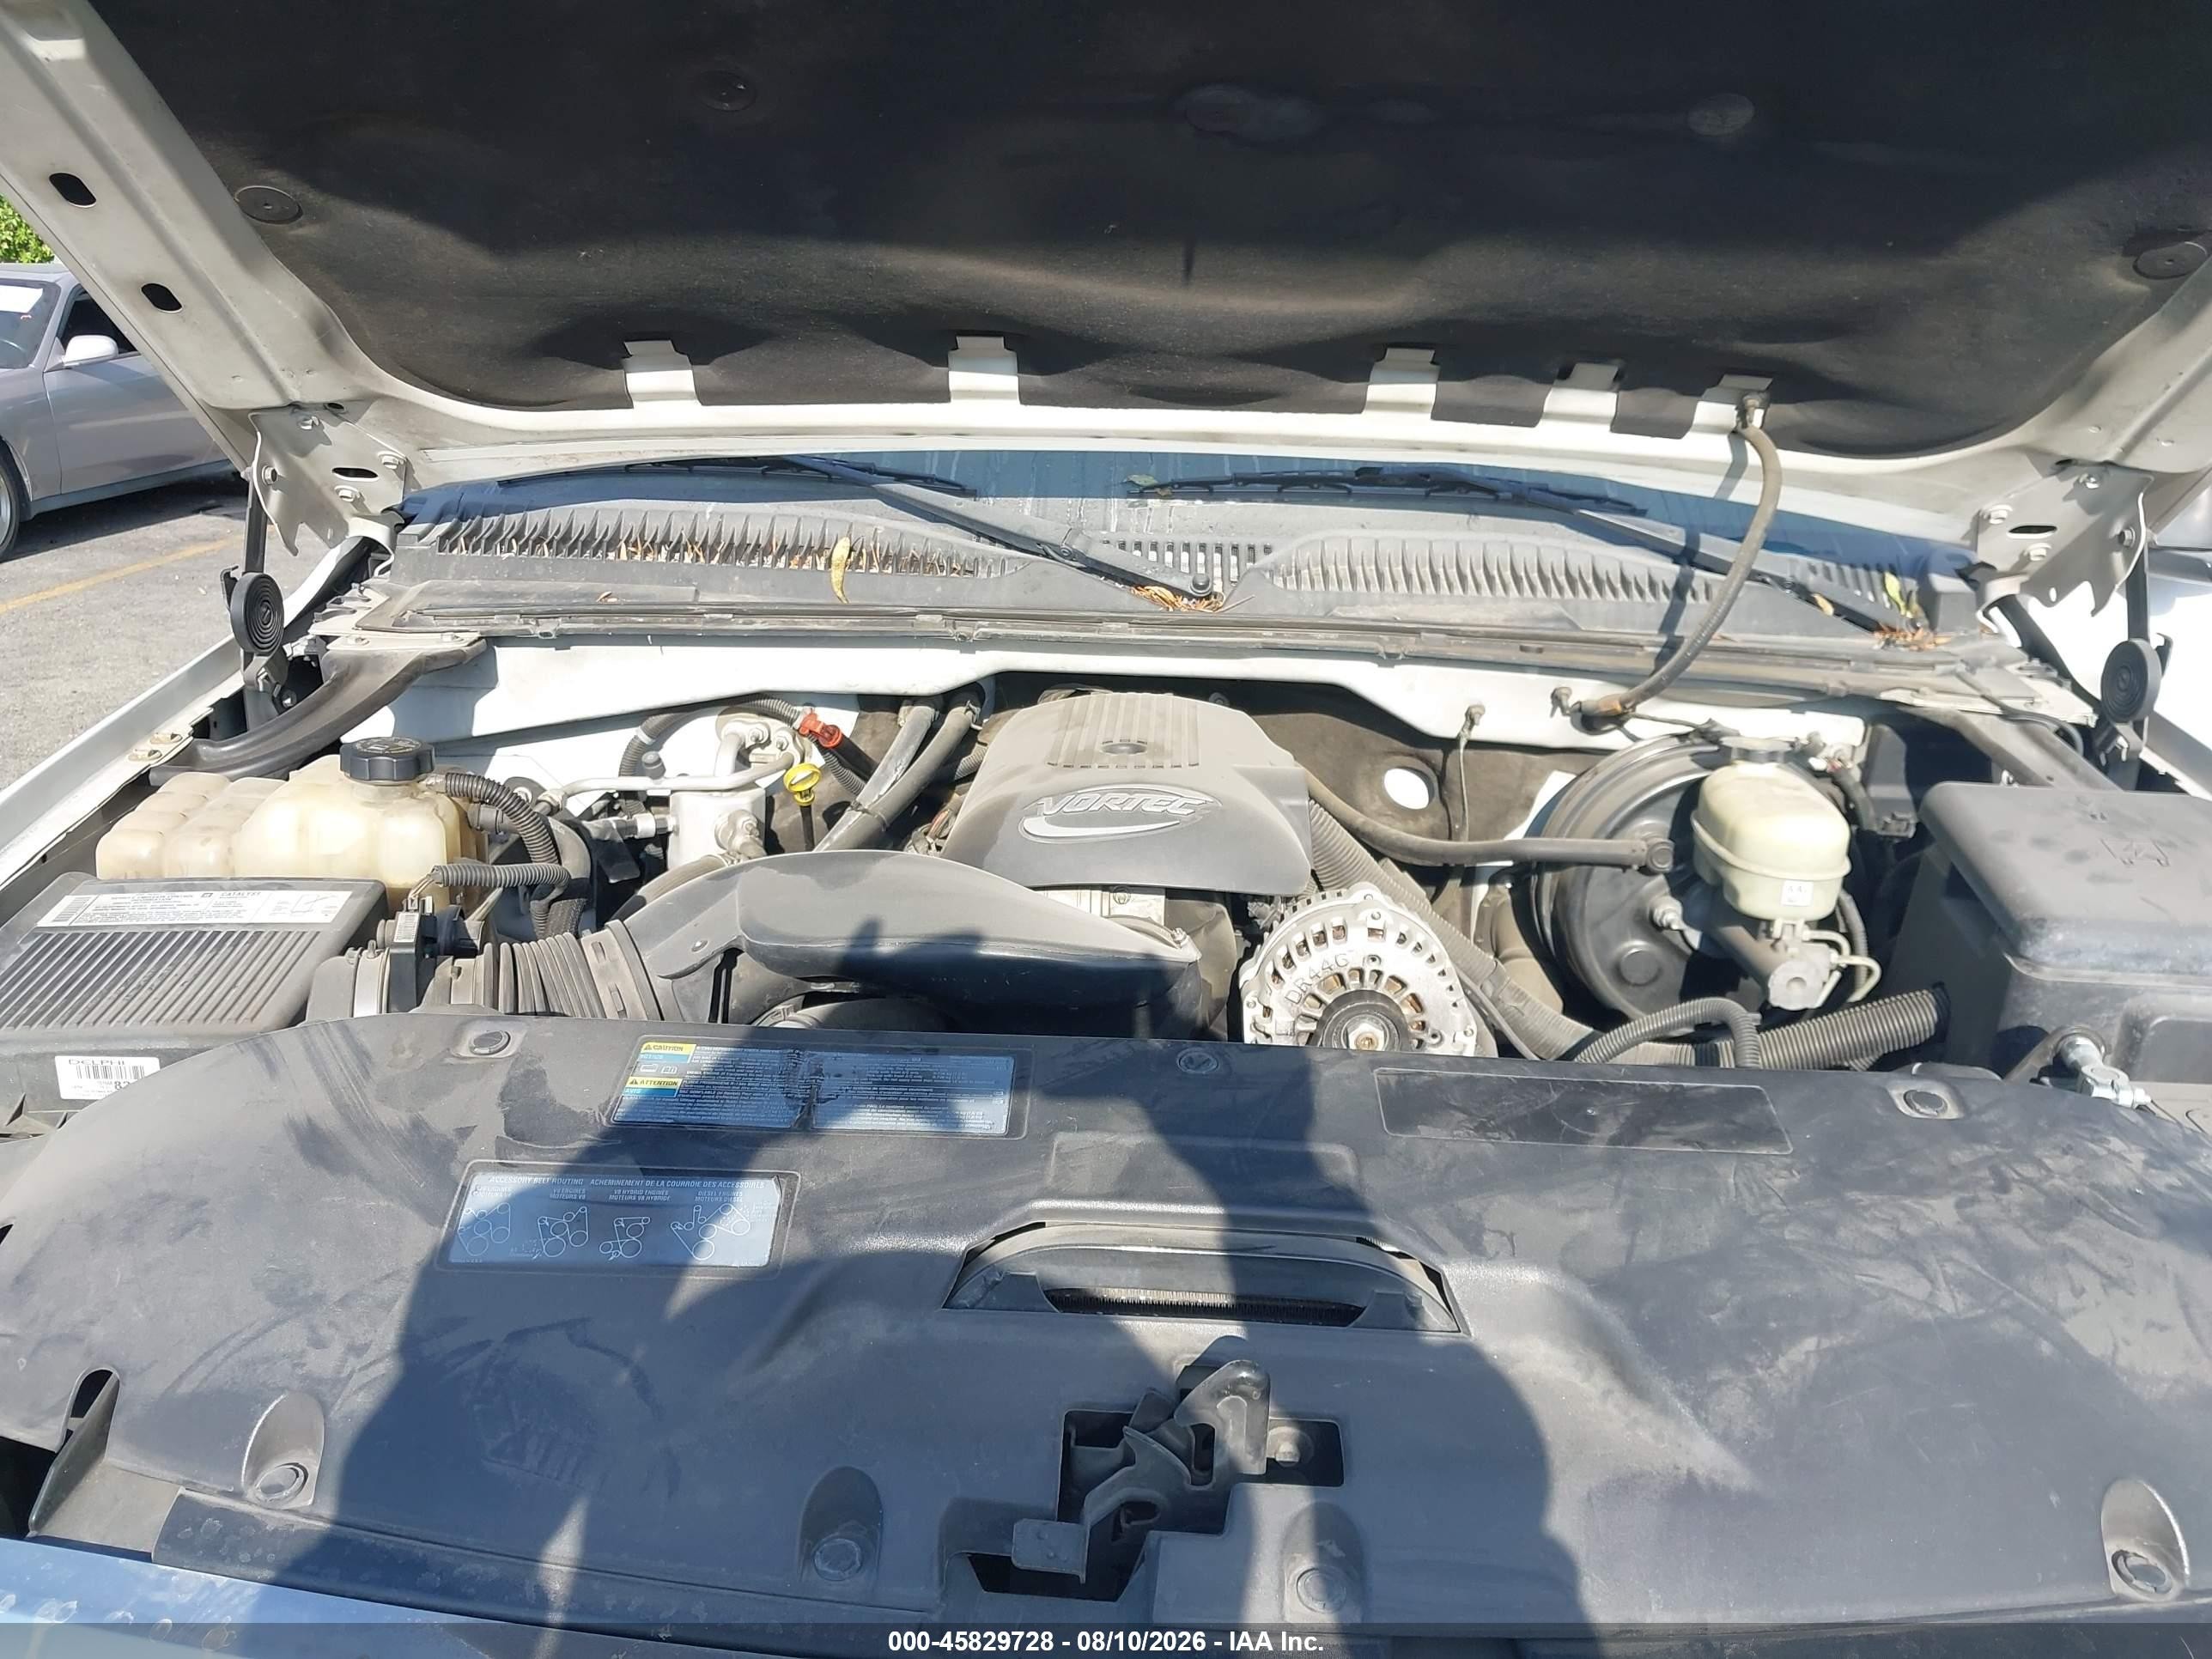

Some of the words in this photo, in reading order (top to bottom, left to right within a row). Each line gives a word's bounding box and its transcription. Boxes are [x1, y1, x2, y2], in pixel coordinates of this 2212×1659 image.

[1037, 794, 1206, 816] VORTEC
[489, 1176, 532, 1184] ACCESSORY
[590, 1178, 644, 1187] ACHEMINEMENT
